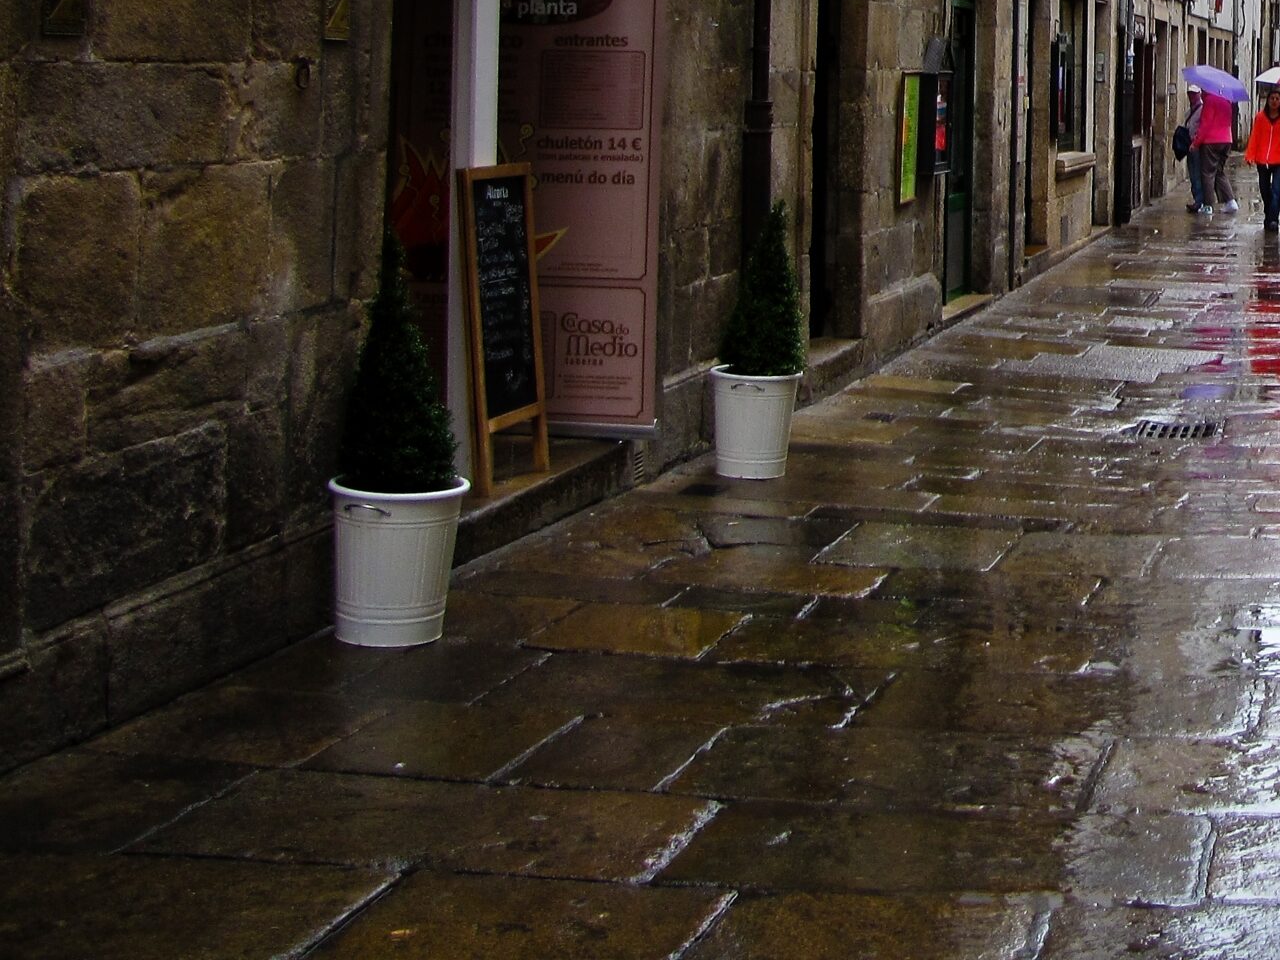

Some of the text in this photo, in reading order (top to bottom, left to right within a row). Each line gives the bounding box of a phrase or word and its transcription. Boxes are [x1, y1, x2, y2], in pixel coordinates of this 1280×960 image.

[554, 33, 628, 47] entrantes
[608, 137, 626, 150] 14
[588, 171, 607, 184] do
[612, 170, 635, 185] día
[560, 312, 629, 335] Casa do
[566, 334, 638, 358] Medio
